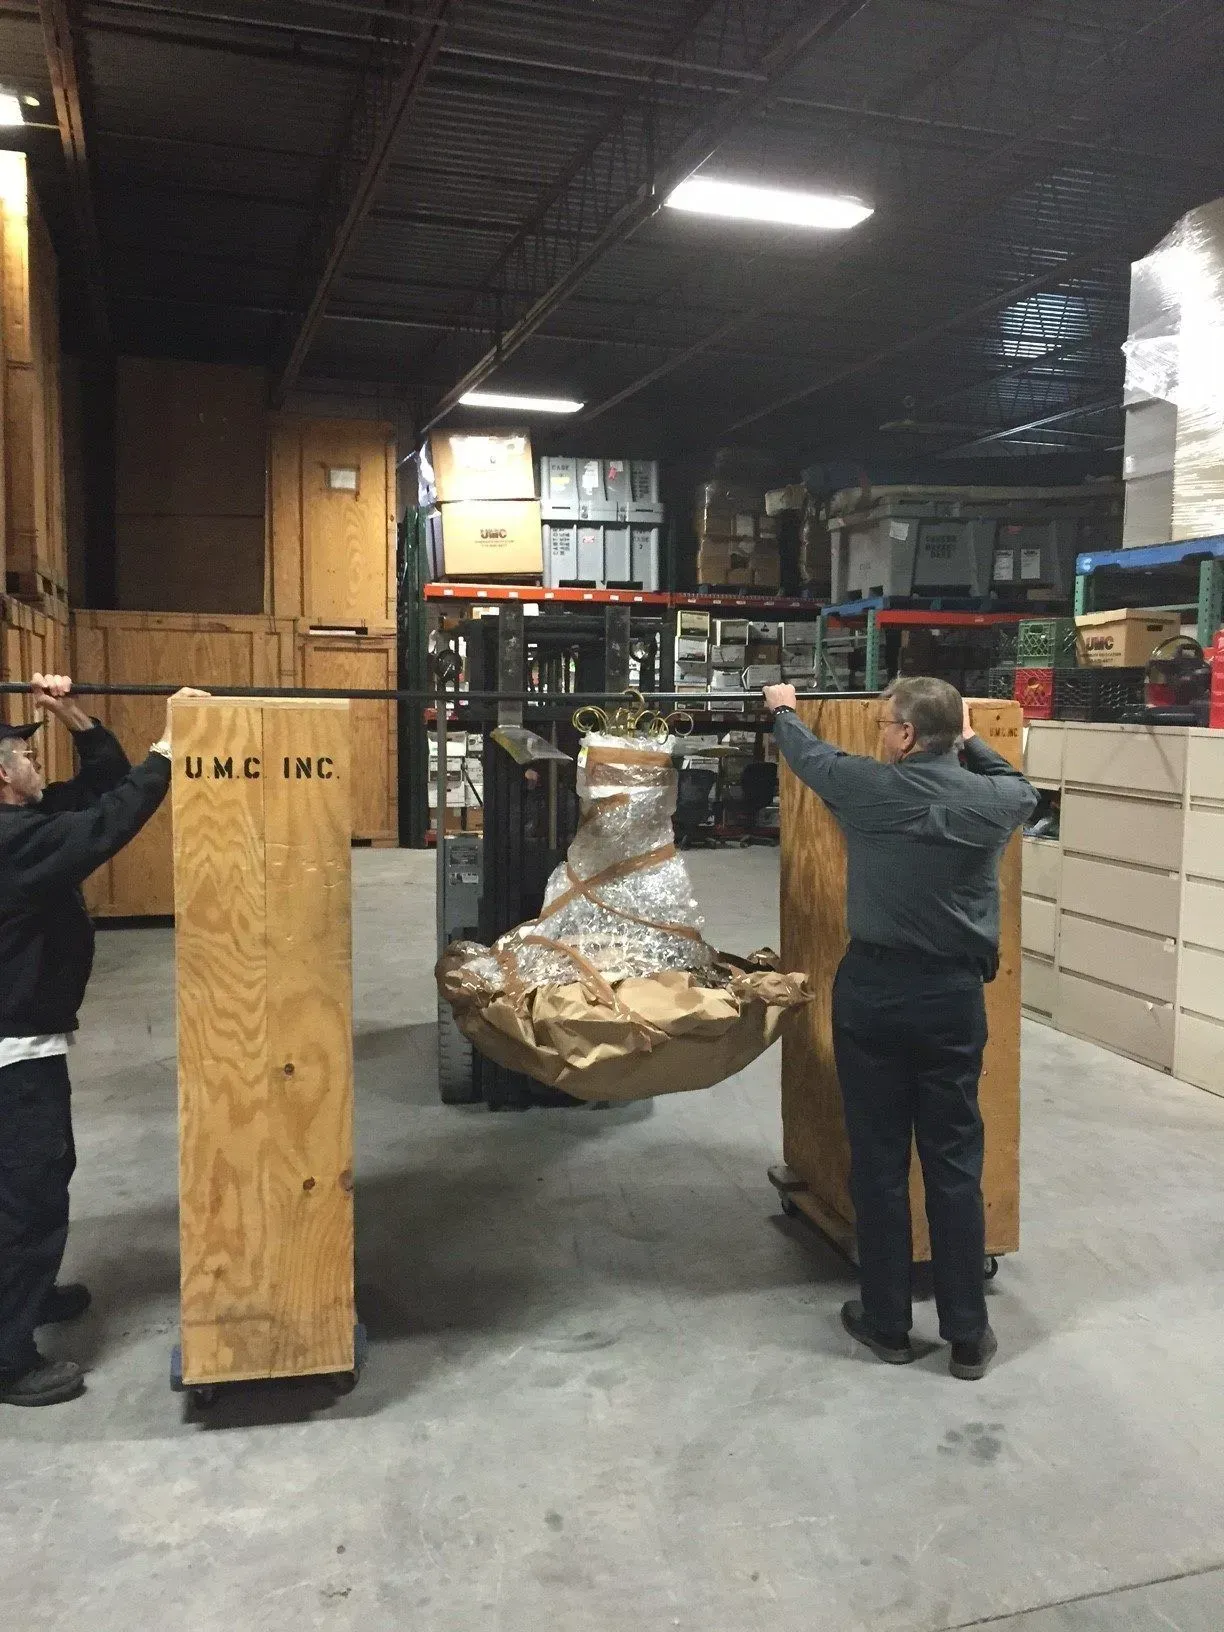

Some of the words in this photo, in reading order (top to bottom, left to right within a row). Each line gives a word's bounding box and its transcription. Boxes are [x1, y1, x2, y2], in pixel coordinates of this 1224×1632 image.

[480, 528, 507, 539] UMC
[1085, 635, 1115, 651] UMC
[283, 756, 340, 779] INC.
